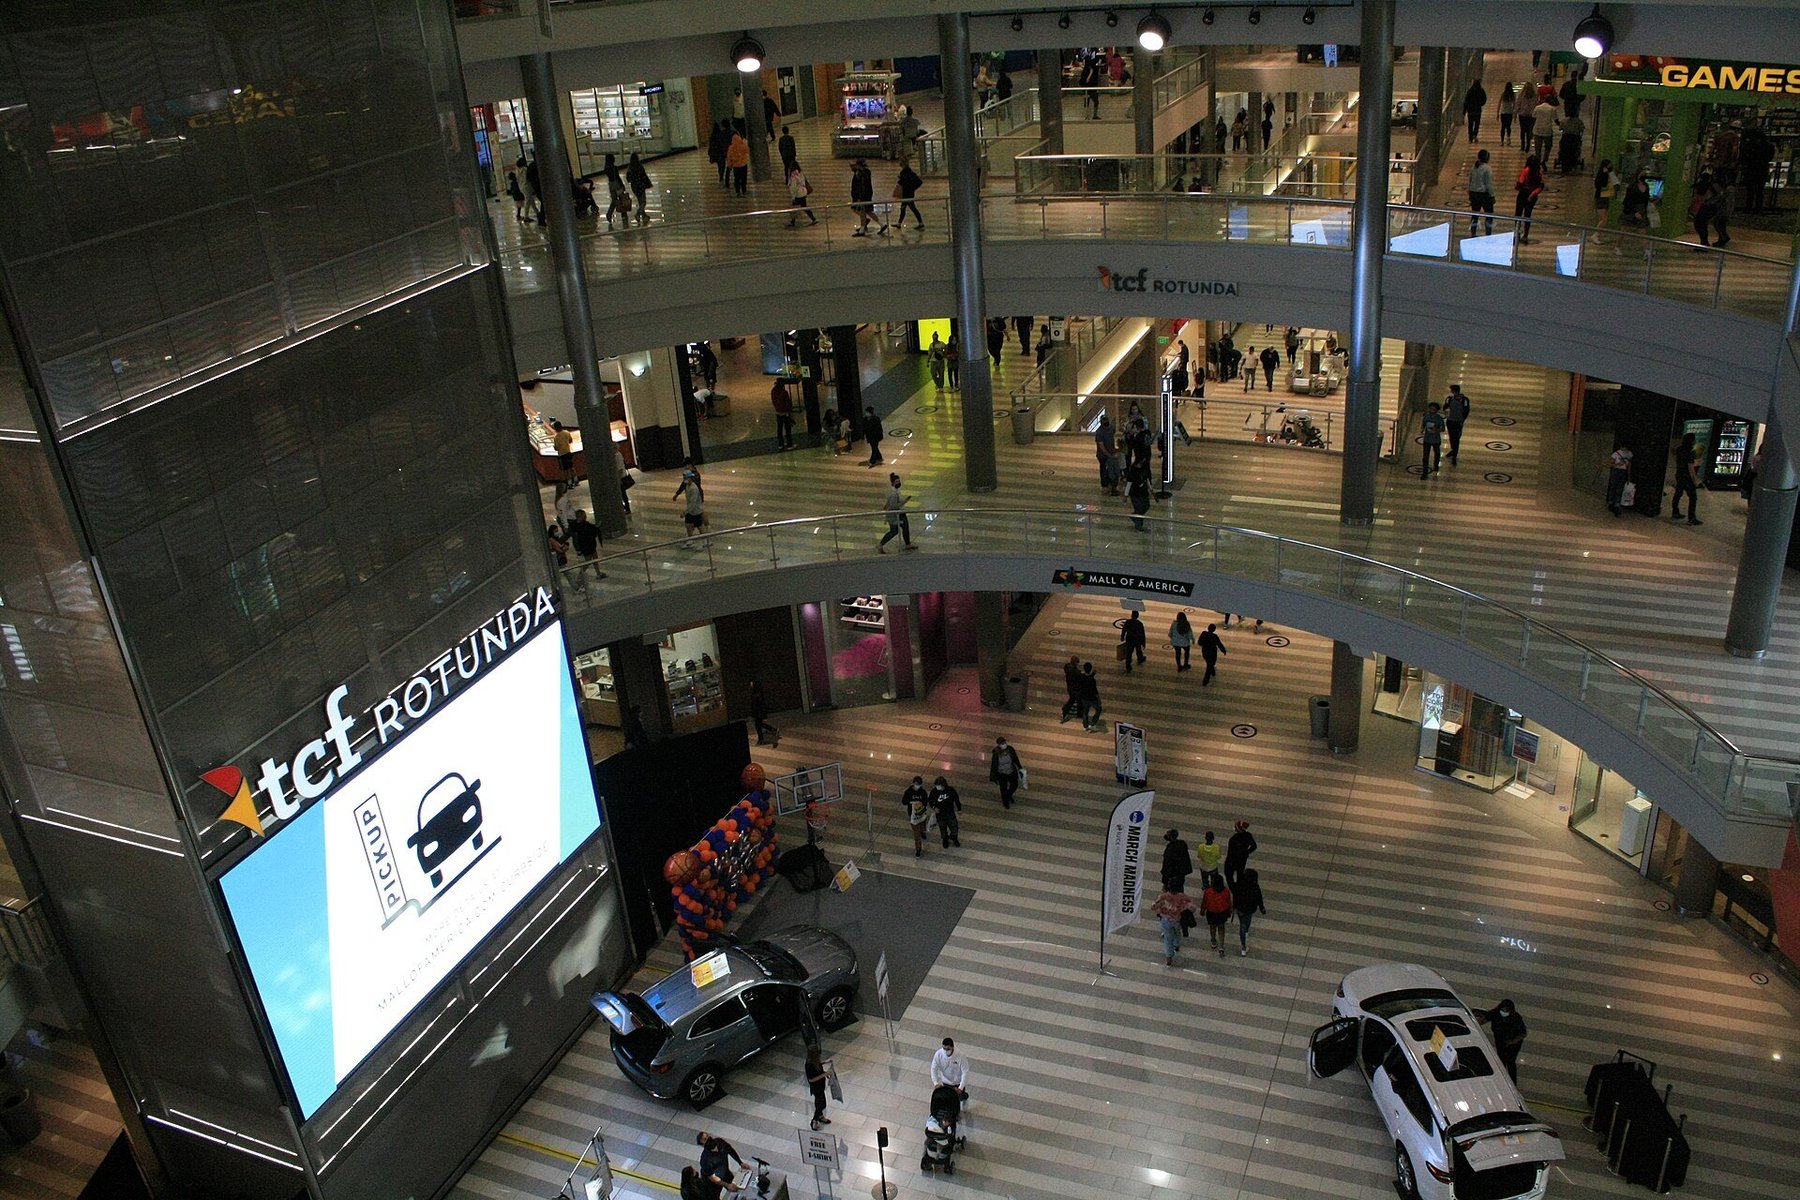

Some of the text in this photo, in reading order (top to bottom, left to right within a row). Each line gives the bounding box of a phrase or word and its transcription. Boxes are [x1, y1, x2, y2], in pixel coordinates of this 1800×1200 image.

[1111, 268, 1237, 296] tcf ROTUNDA
[1089, 575, 1187, 593] MALL OF AMERICA
[257, 586, 555, 821] tcf ROTUNDA
[362, 809, 400, 908] PICKUP
[1122, 825, 1141, 914] MARCH MADNESS
